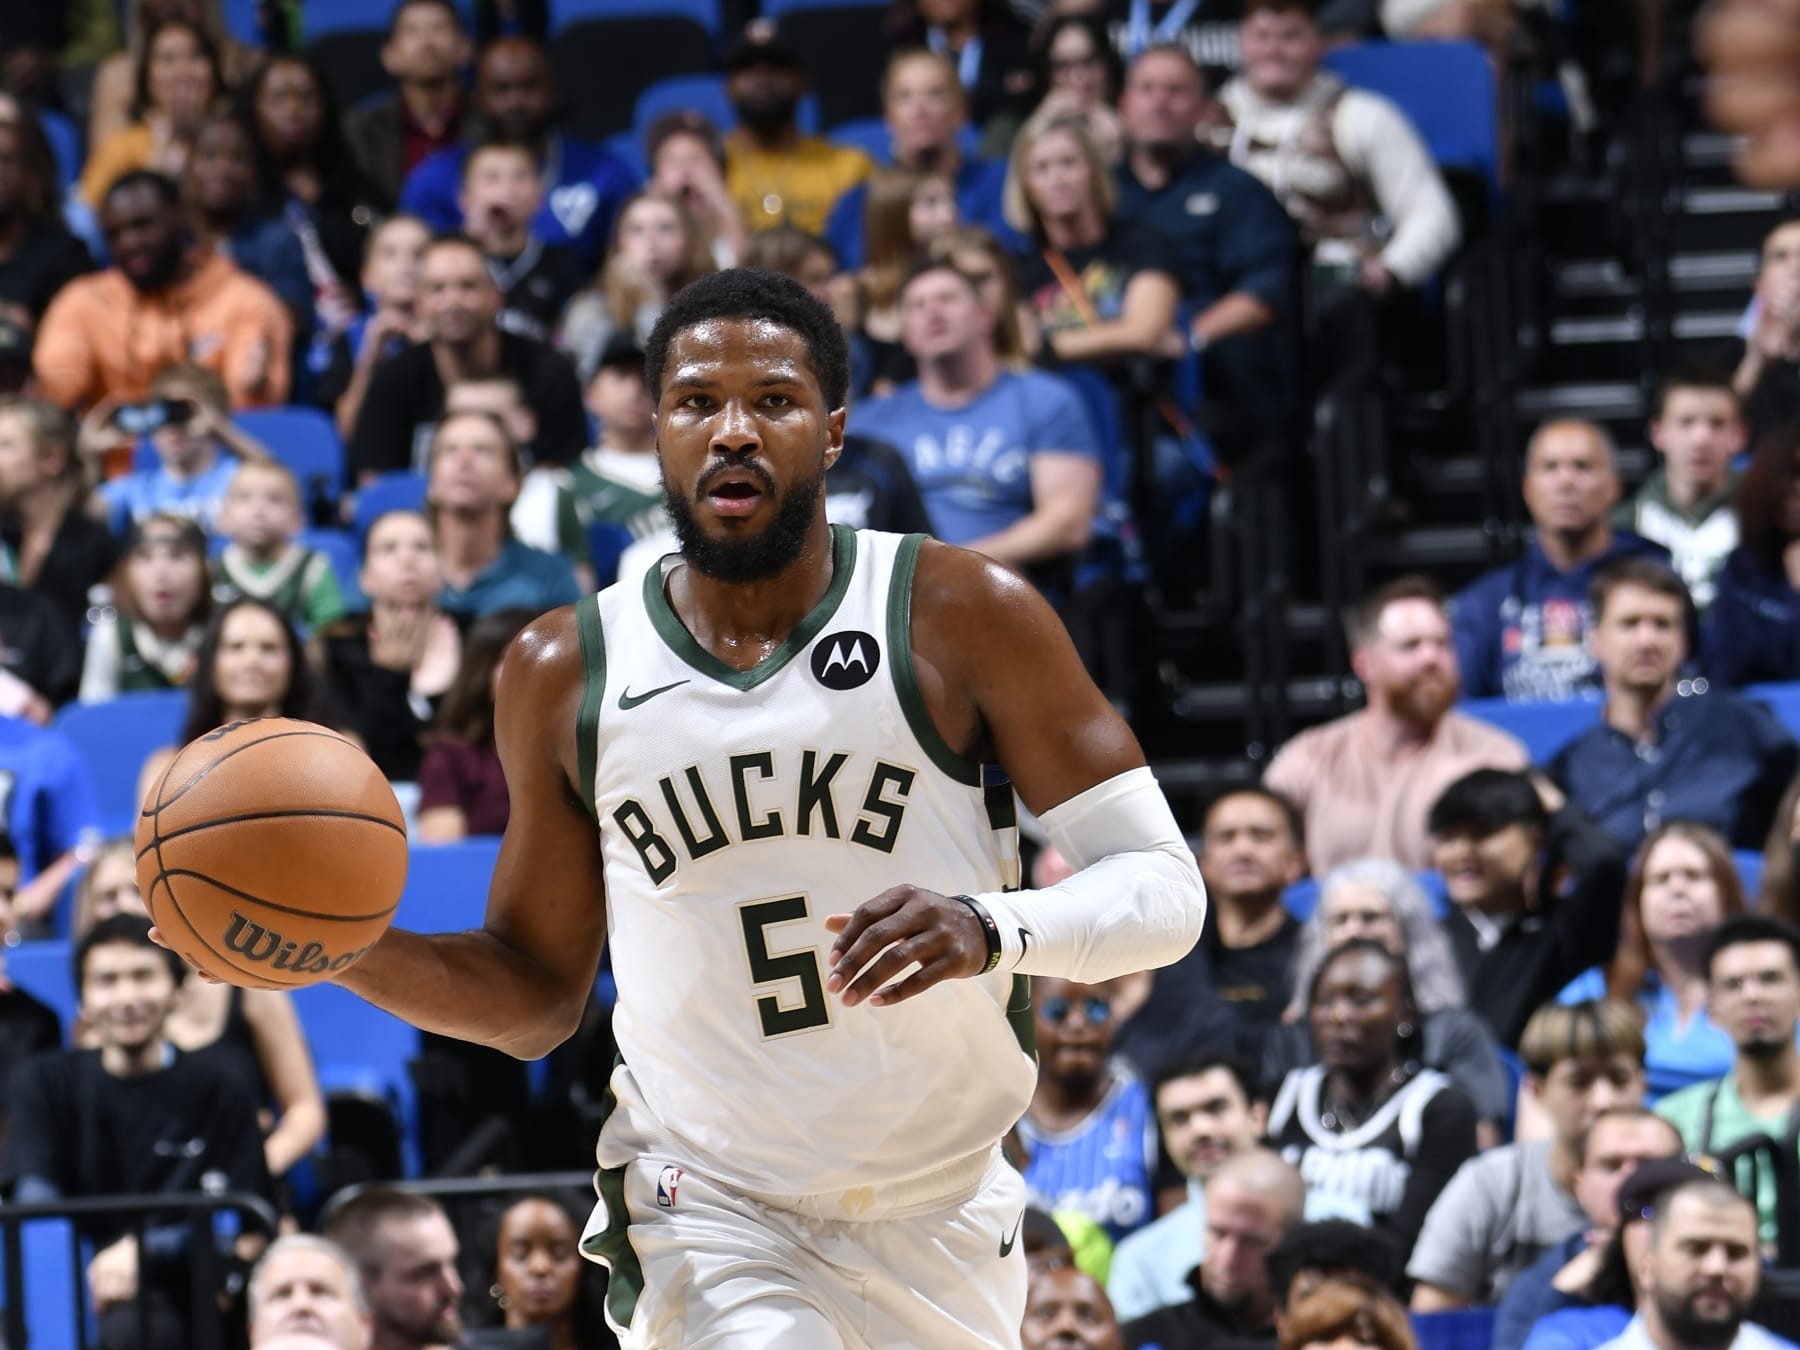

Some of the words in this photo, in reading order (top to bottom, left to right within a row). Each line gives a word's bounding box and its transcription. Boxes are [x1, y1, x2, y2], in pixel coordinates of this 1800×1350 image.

[611, 747, 920, 888] BUCKS
[223, 909, 374, 974] Wilso
[736, 890, 833, 1041] 5
